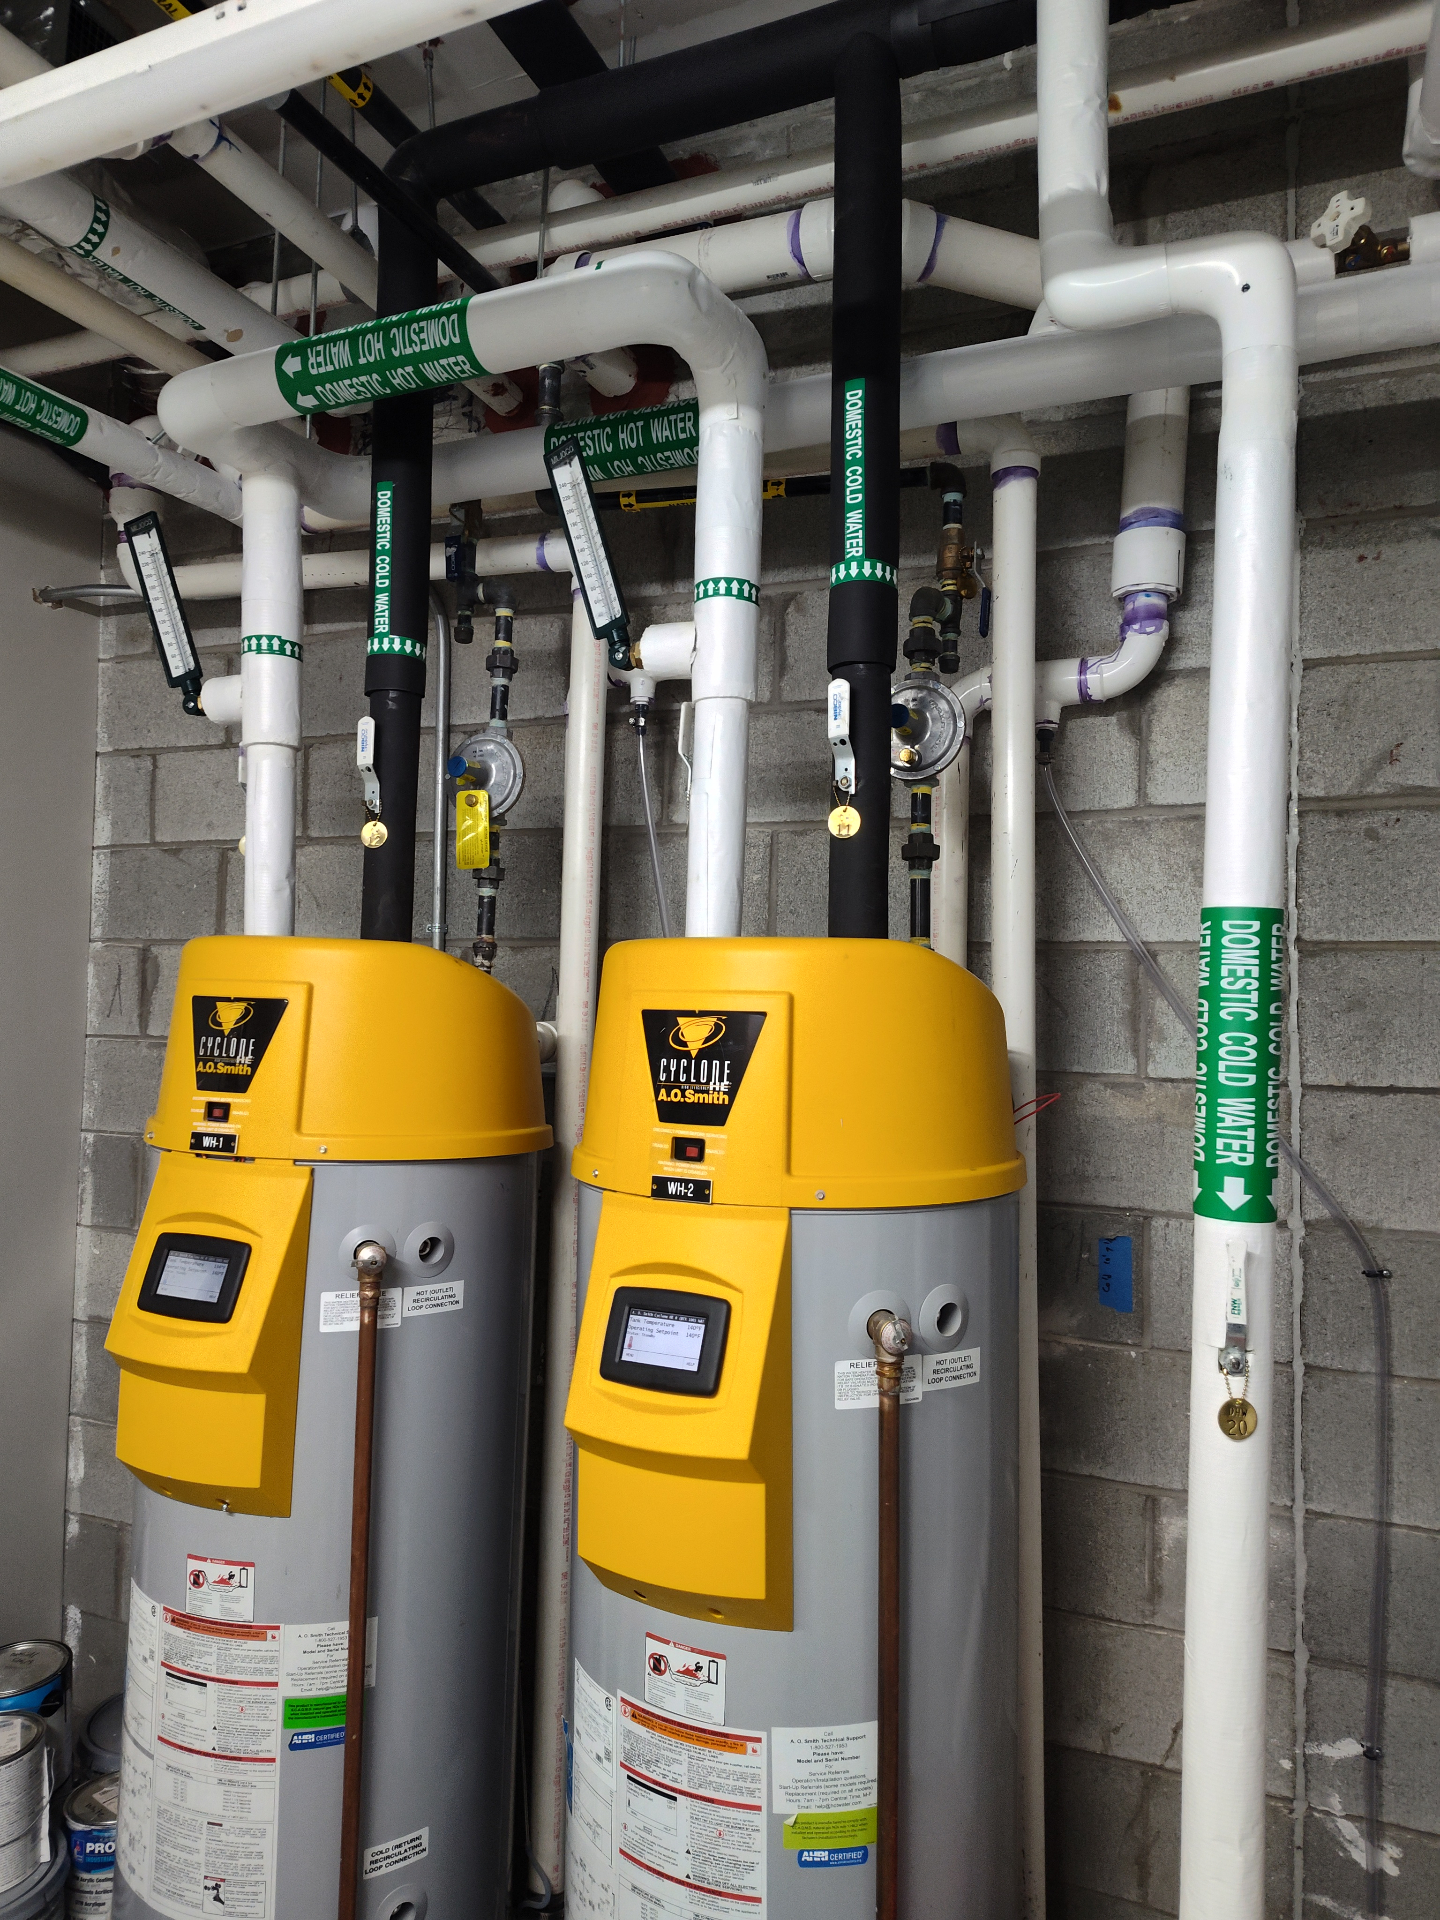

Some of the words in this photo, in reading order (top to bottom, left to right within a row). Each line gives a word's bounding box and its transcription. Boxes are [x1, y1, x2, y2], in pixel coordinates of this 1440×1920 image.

[391, 313, 461, 357] DOMESTIC
[308, 338, 353, 375] WATER
[358, 331, 386, 364] HOT
[315, 373, 391, 406] DOMESTIC
[386, 365, 423, 390] HOT
[419, 355, 479, 383] WATER
[14, 389, 38, 415] HOT
[36, 399, 81, 436] DOMESTIC
[845, 389, 863, 460] DOMESTIC
[618, 421, 644, 450] HOT
[650, 412, 697, 444] WATER
[607, 459, 637, 478] HOT
[845, 465, 863, 504] COLD
[376, 490, 391, 550] DOMESTIC
[845, 509, 863, 558] WATER
[376, 555, 390, 588] COLD
[374, 593, 389, 634] WATER
[1219, 920, 1261, 1021] DOMESTIC
[199, 1036, 255, 1058] CYCLONE
[1218, 1031, 1258, 1087] COLD
[659, 1058, 731, 1084] CYCLONE
[709, 1081, 729, 1092] HE
[202, 1136, 224, 1149] WH-1
[1215, 1097, 1256, 1167] WATER
[667, 1181, 694, 1197] WH-2
[407, 1304, 424, 1312] LOOP
[425, 1300, 460, 1310] CONNECTION
[412, 1293, 457, 1303] RECIRCULATING
[628, 1324, 653, 1333] Operating
[656, 1328, 679, 1336] Setpoint
[643, 1318, 675, 1328] Temperature
[932, 1363, 974, 1375] RECIRCULATING
[945, 1371, 977, 1382] CONNECTION
[1228, 1420, 1248, 1436] 20
[291, 1734, 315, 1744] AHRI
[316, 1732, 345, 1742] CERTIFIED
[846, 1734, 866, 1742] Support
[843, 1773, 866, 1781] questions
[785, 1790, 817, 1798] Replacement
[86, 1842, 115, 1854] PRO
[369, 1842, 423, 1866] RECIRCULATING
[371, 1847, 390, 1858] COLD
[391, 1834, 422, 1851] (RETURN)
[801, 1851, 828, 1862] AHRI
[829, 1851, 863, 1861] CERTIFIED
[364, 1865, 383, 1875] LOOP
[385, 1847, 427, 1868] CONNECTION
